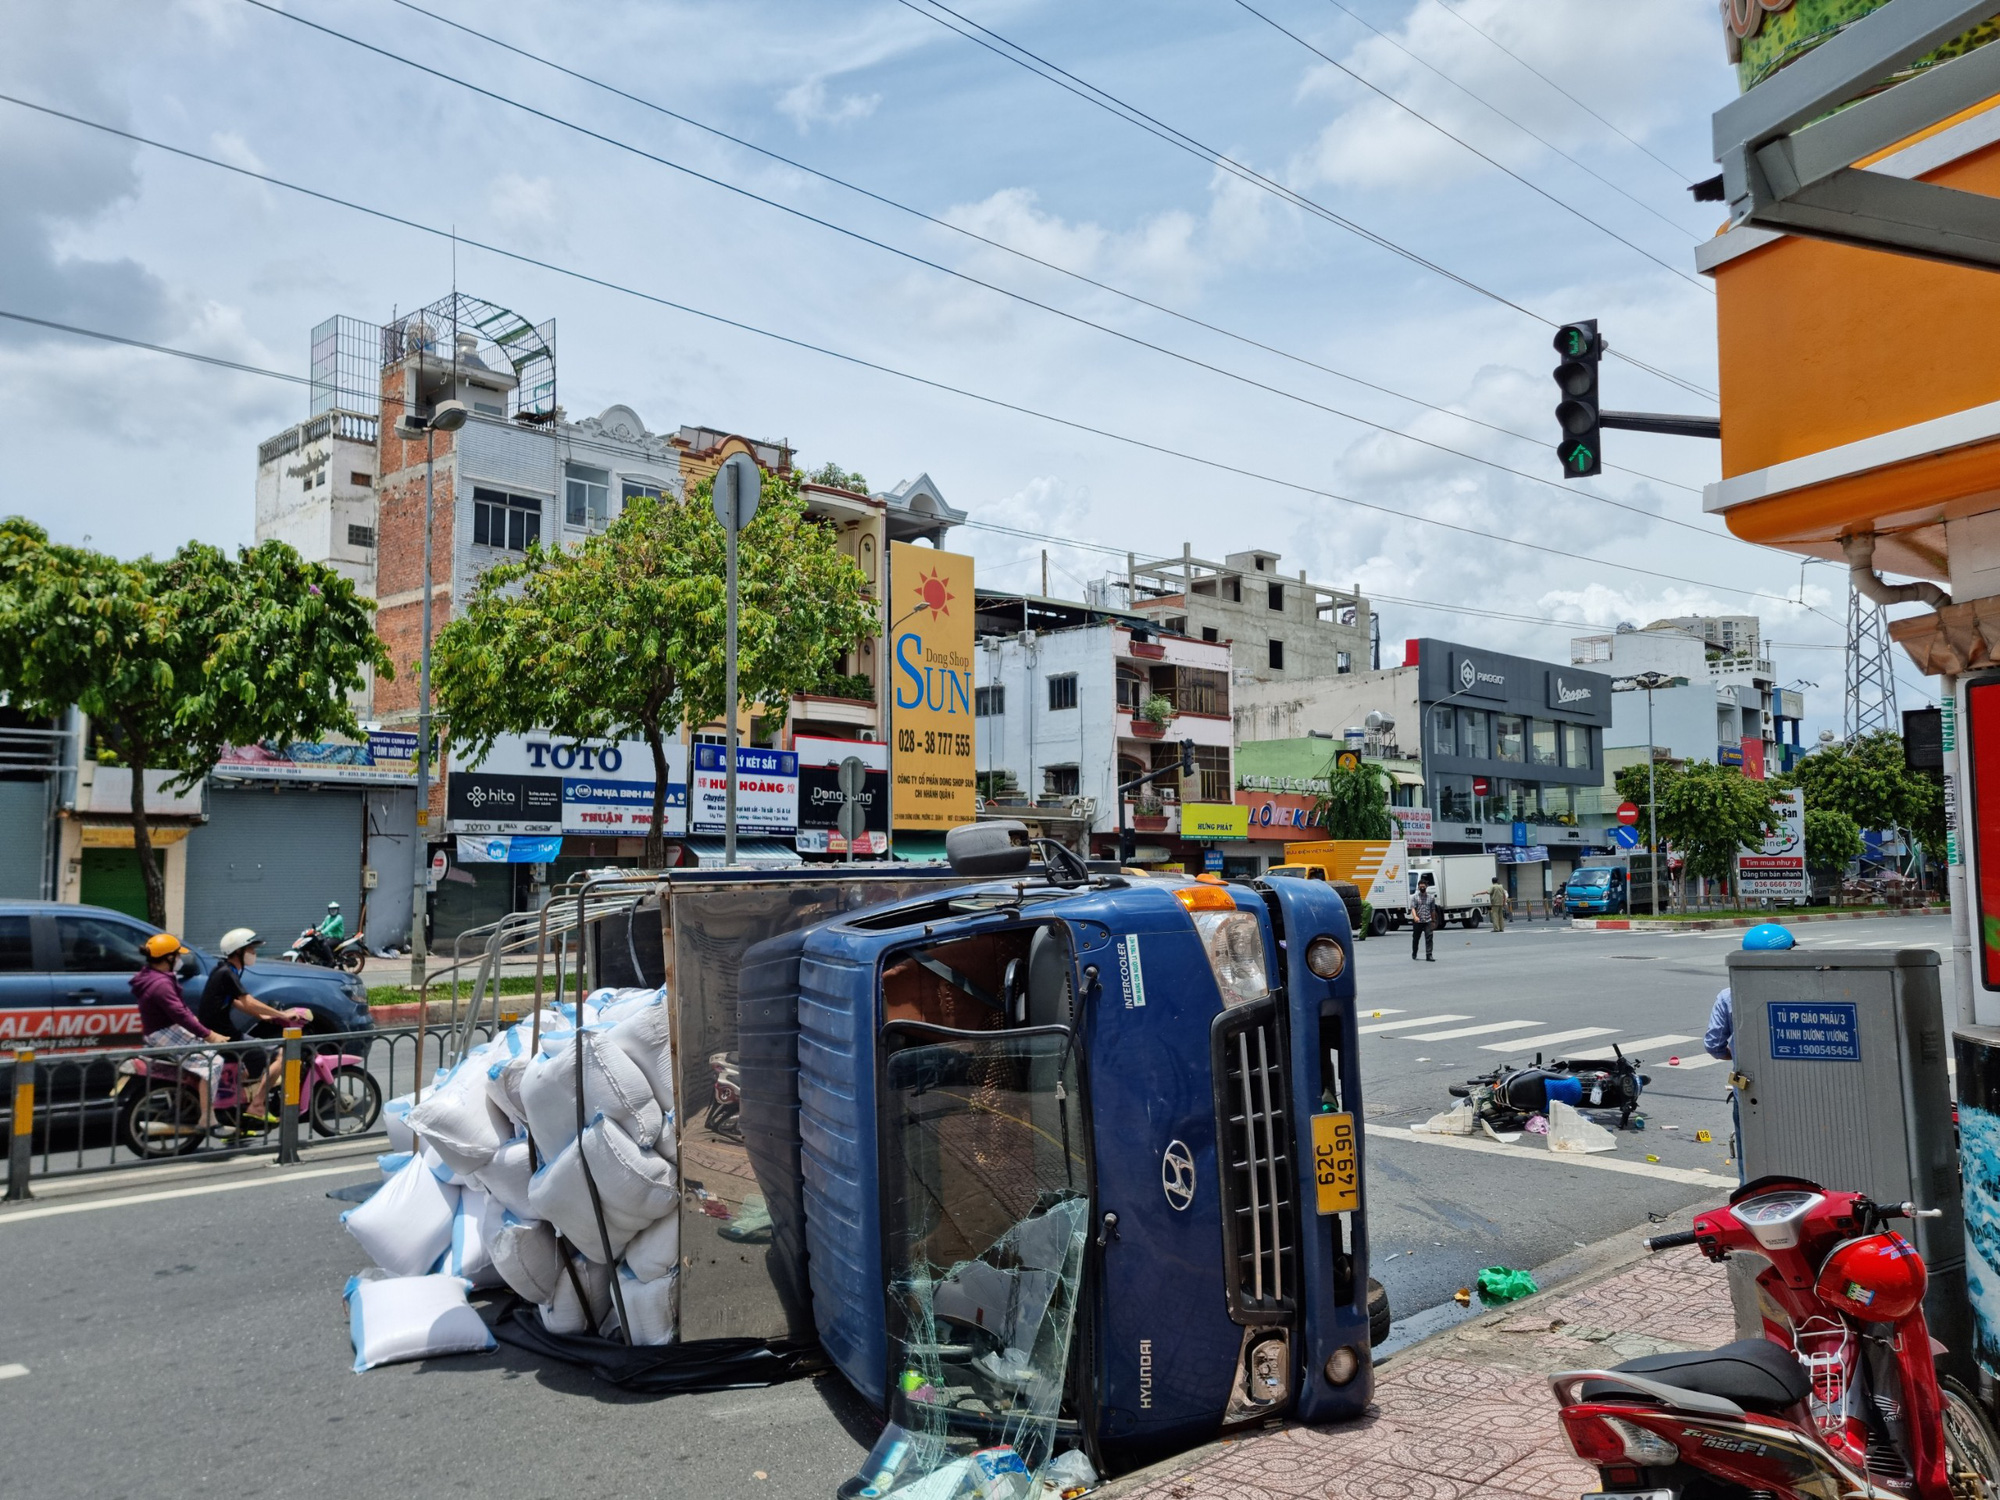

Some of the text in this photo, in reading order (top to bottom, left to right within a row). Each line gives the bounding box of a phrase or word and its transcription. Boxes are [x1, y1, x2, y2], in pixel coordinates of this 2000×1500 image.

[926, 648, 969, 671] Dong Shop
[896, 633, 971, 715] SUN
[898, 729, 915, 753] 028
[924, 731, 935, 754] 38
[938, 732, 952, 755] 777
[955, 733, 970, 757] 555
[526, 742, 622, 772] TOTO
[710, 779, 784, 793] HU HOÀNG
[911, 776, 917, 784] TY
[488, 788, 515, 802] hita
[1198, 822, 1232, 831] HƯNG PHÁT
[1117, 942, 1134, 1009] INTERCOOLER
[1789, 1012, 1799, 1023] PP
[1776, 1029, 1785, 1039] 74
[1786, 1029, 1801, 1039] KINH
[1799, 1044, 1854, 1056] 1900545454
[1316, 1144, 1335, 1185] 62C
[1334, 1124, 1356, 1197] 149.90
[1140, 1339, 1152, 1409] HYUNDAI
